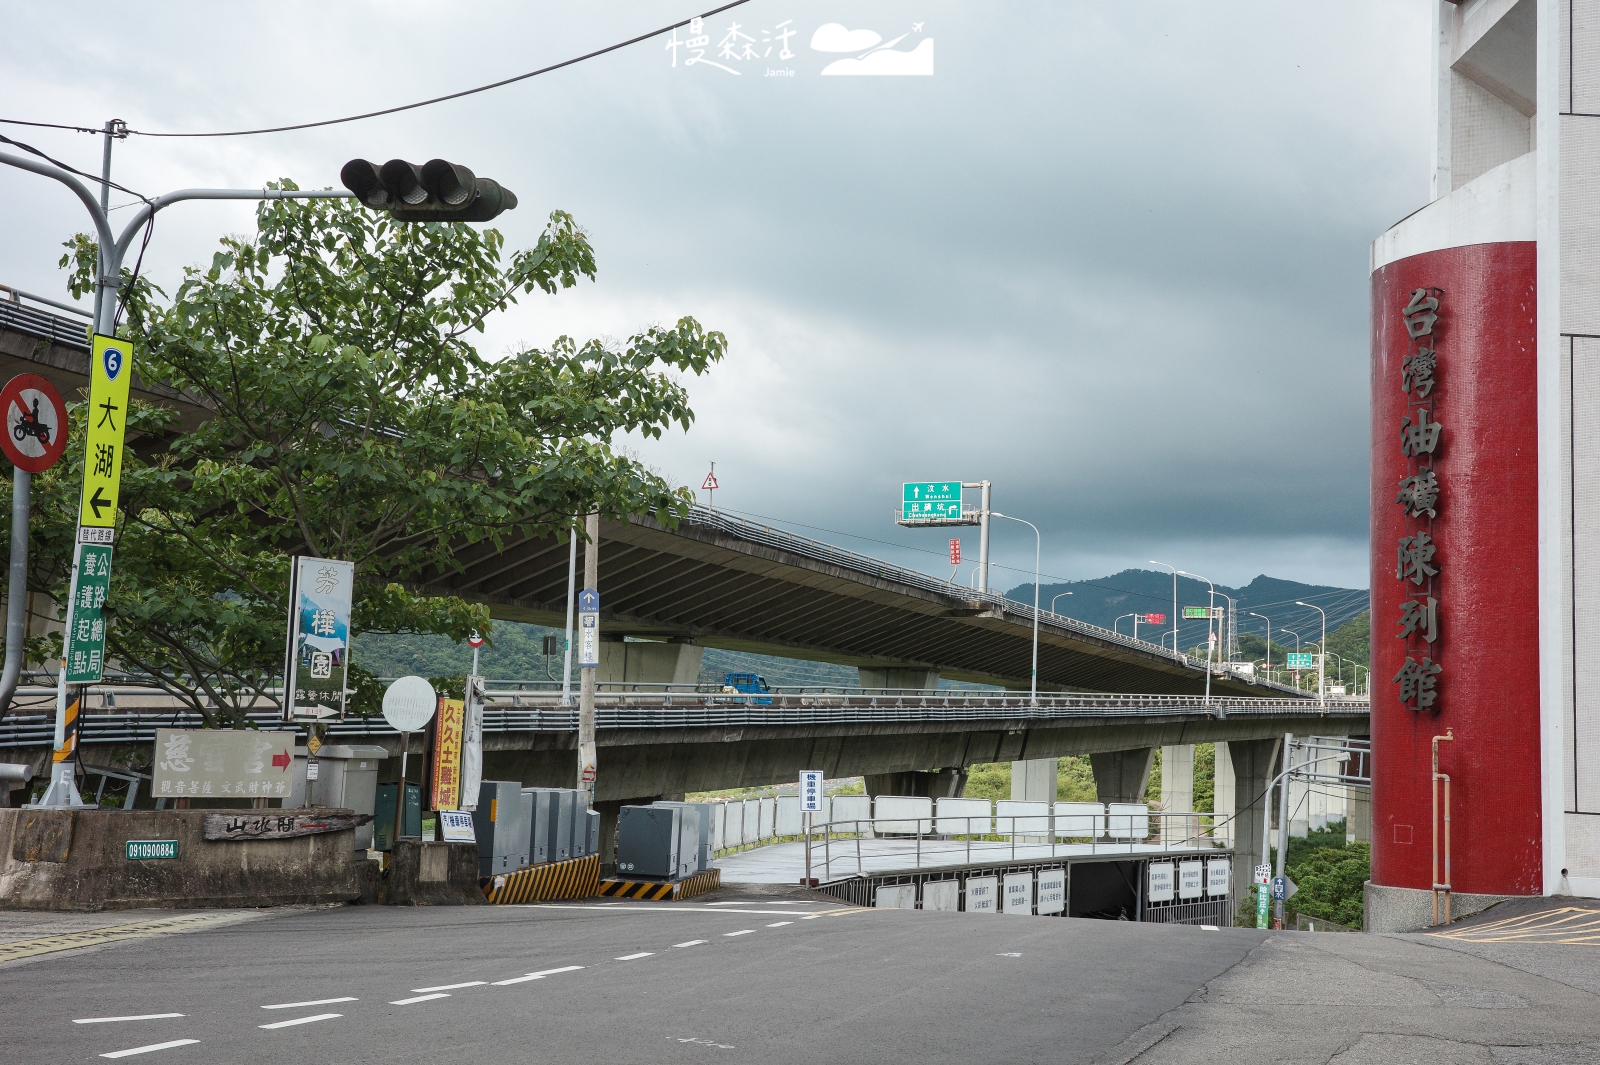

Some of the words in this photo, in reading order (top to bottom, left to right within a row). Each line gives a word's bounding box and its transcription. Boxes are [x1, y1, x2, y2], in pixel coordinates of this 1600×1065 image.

[108, 353, 117, 370] 6
[93, 396, 119, 478] 大湖
[927, 484, 949, 493] 汶水
[1392, 288, 1443, 709] 台灣油礦陳列館
[82, 528, 112, 542] 替代路線
[72, 552, 97, 676] 養護起點
[87, 552, 109, 675] 公路總局
[310, 566, 339, 679] 芳樺園
[161, 780, 213, 795] 觀音菩薩
[221, 780, 287, 795] 文武財神爺
[806, 773, 817, 810] 機車停車場
[129, 843, 174, 857] 0910900884
[1258, 885, 1268, 909] 哈比丘
